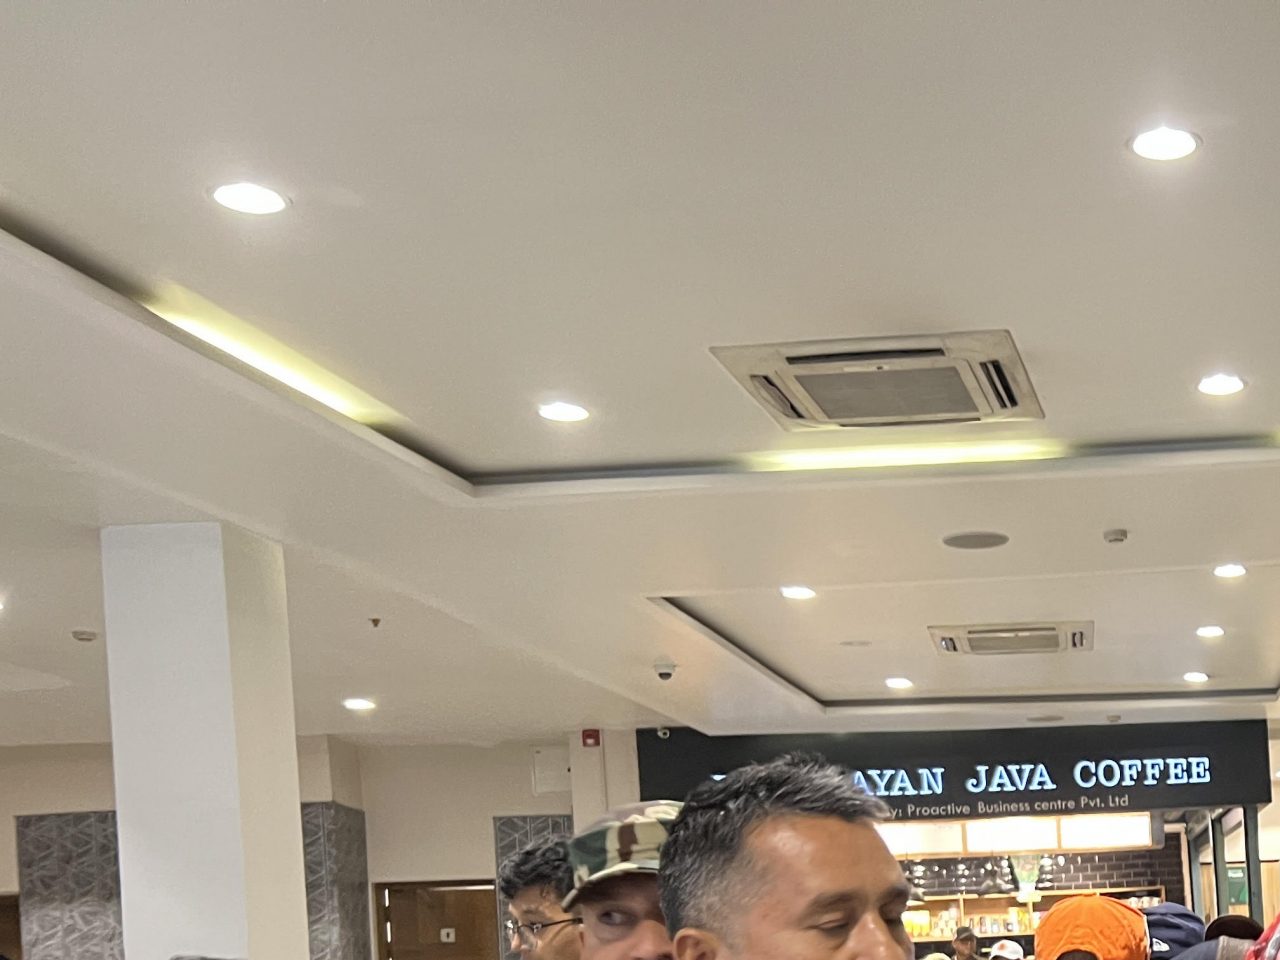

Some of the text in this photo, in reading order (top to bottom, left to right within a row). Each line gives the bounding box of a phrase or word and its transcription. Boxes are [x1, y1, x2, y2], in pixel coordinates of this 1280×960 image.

[965, 763, 1057, 793] JAVA
[1073, 757, 1211, 788] COFFEE
[908, 803, 971, 817] Proactive
[977, 800, 1031, 814] Business
[1034, 799, 1076, 812] centre
[1081, 796, 1105, 809] Pvt.
[1109, 794, 1129, 808] Ltd
